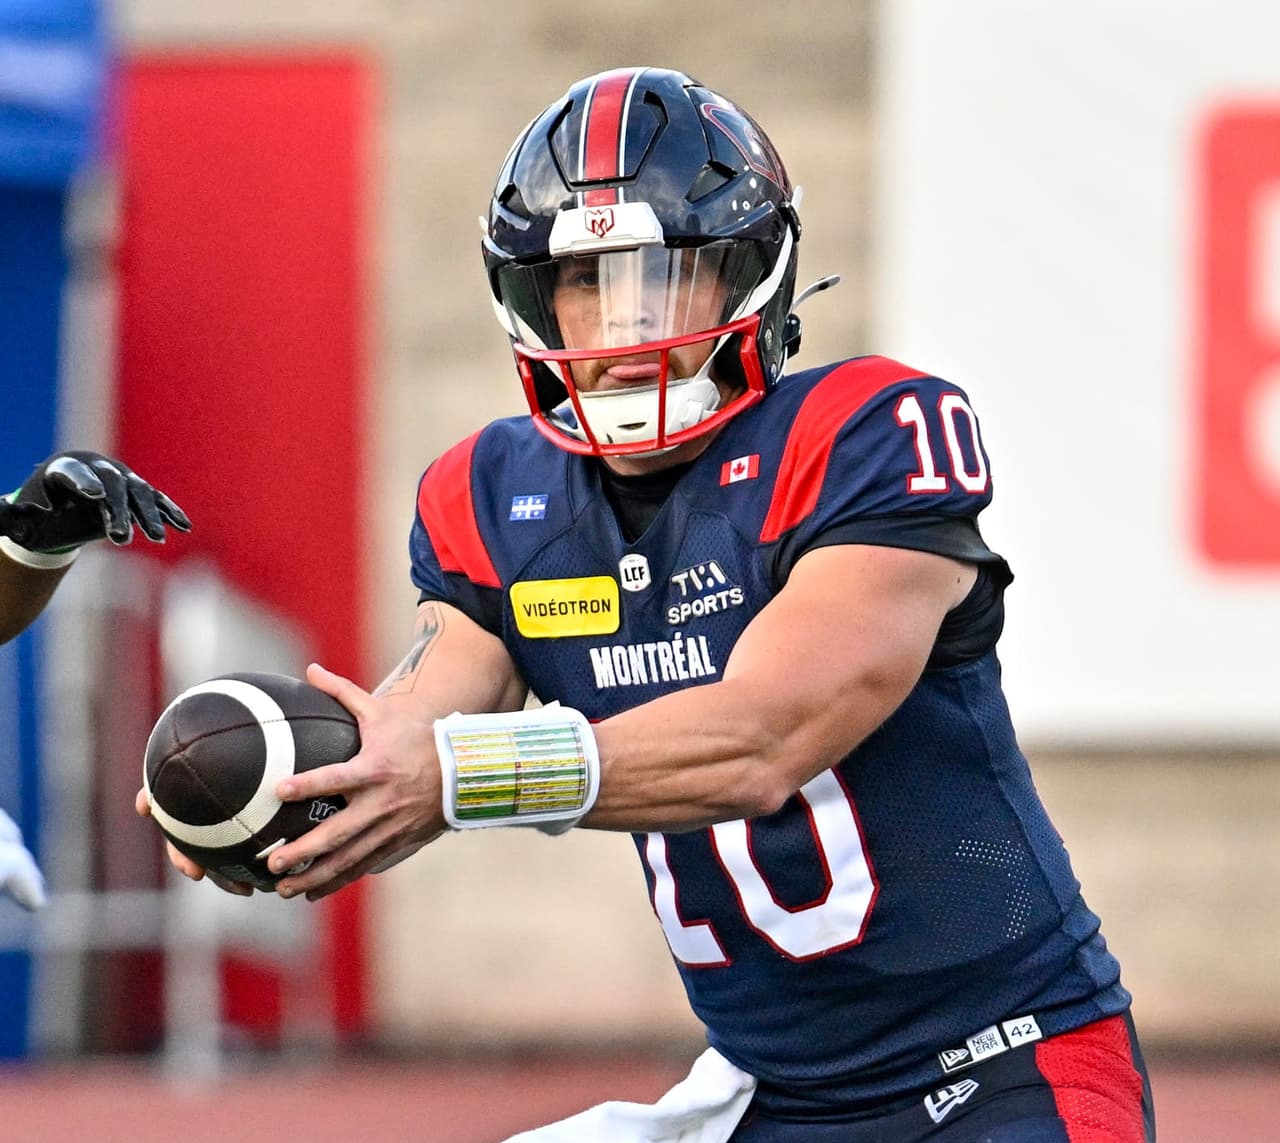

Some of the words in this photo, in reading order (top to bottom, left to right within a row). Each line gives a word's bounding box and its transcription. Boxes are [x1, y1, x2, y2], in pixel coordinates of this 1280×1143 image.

[894, 392, 991, 494] 10
[624, 566, 646, 583] LCF
[522, 598, 612, 618] VIDÉOTRON
[668, 588, 744, 625] SPORTS
[589, 632, 716, 689] MONTRÉAL
[1010, 1023, 1036, 1038] 42
[972, 1032, 996, 1048] NEW
[975, 1041, 999, 1055] ERA
